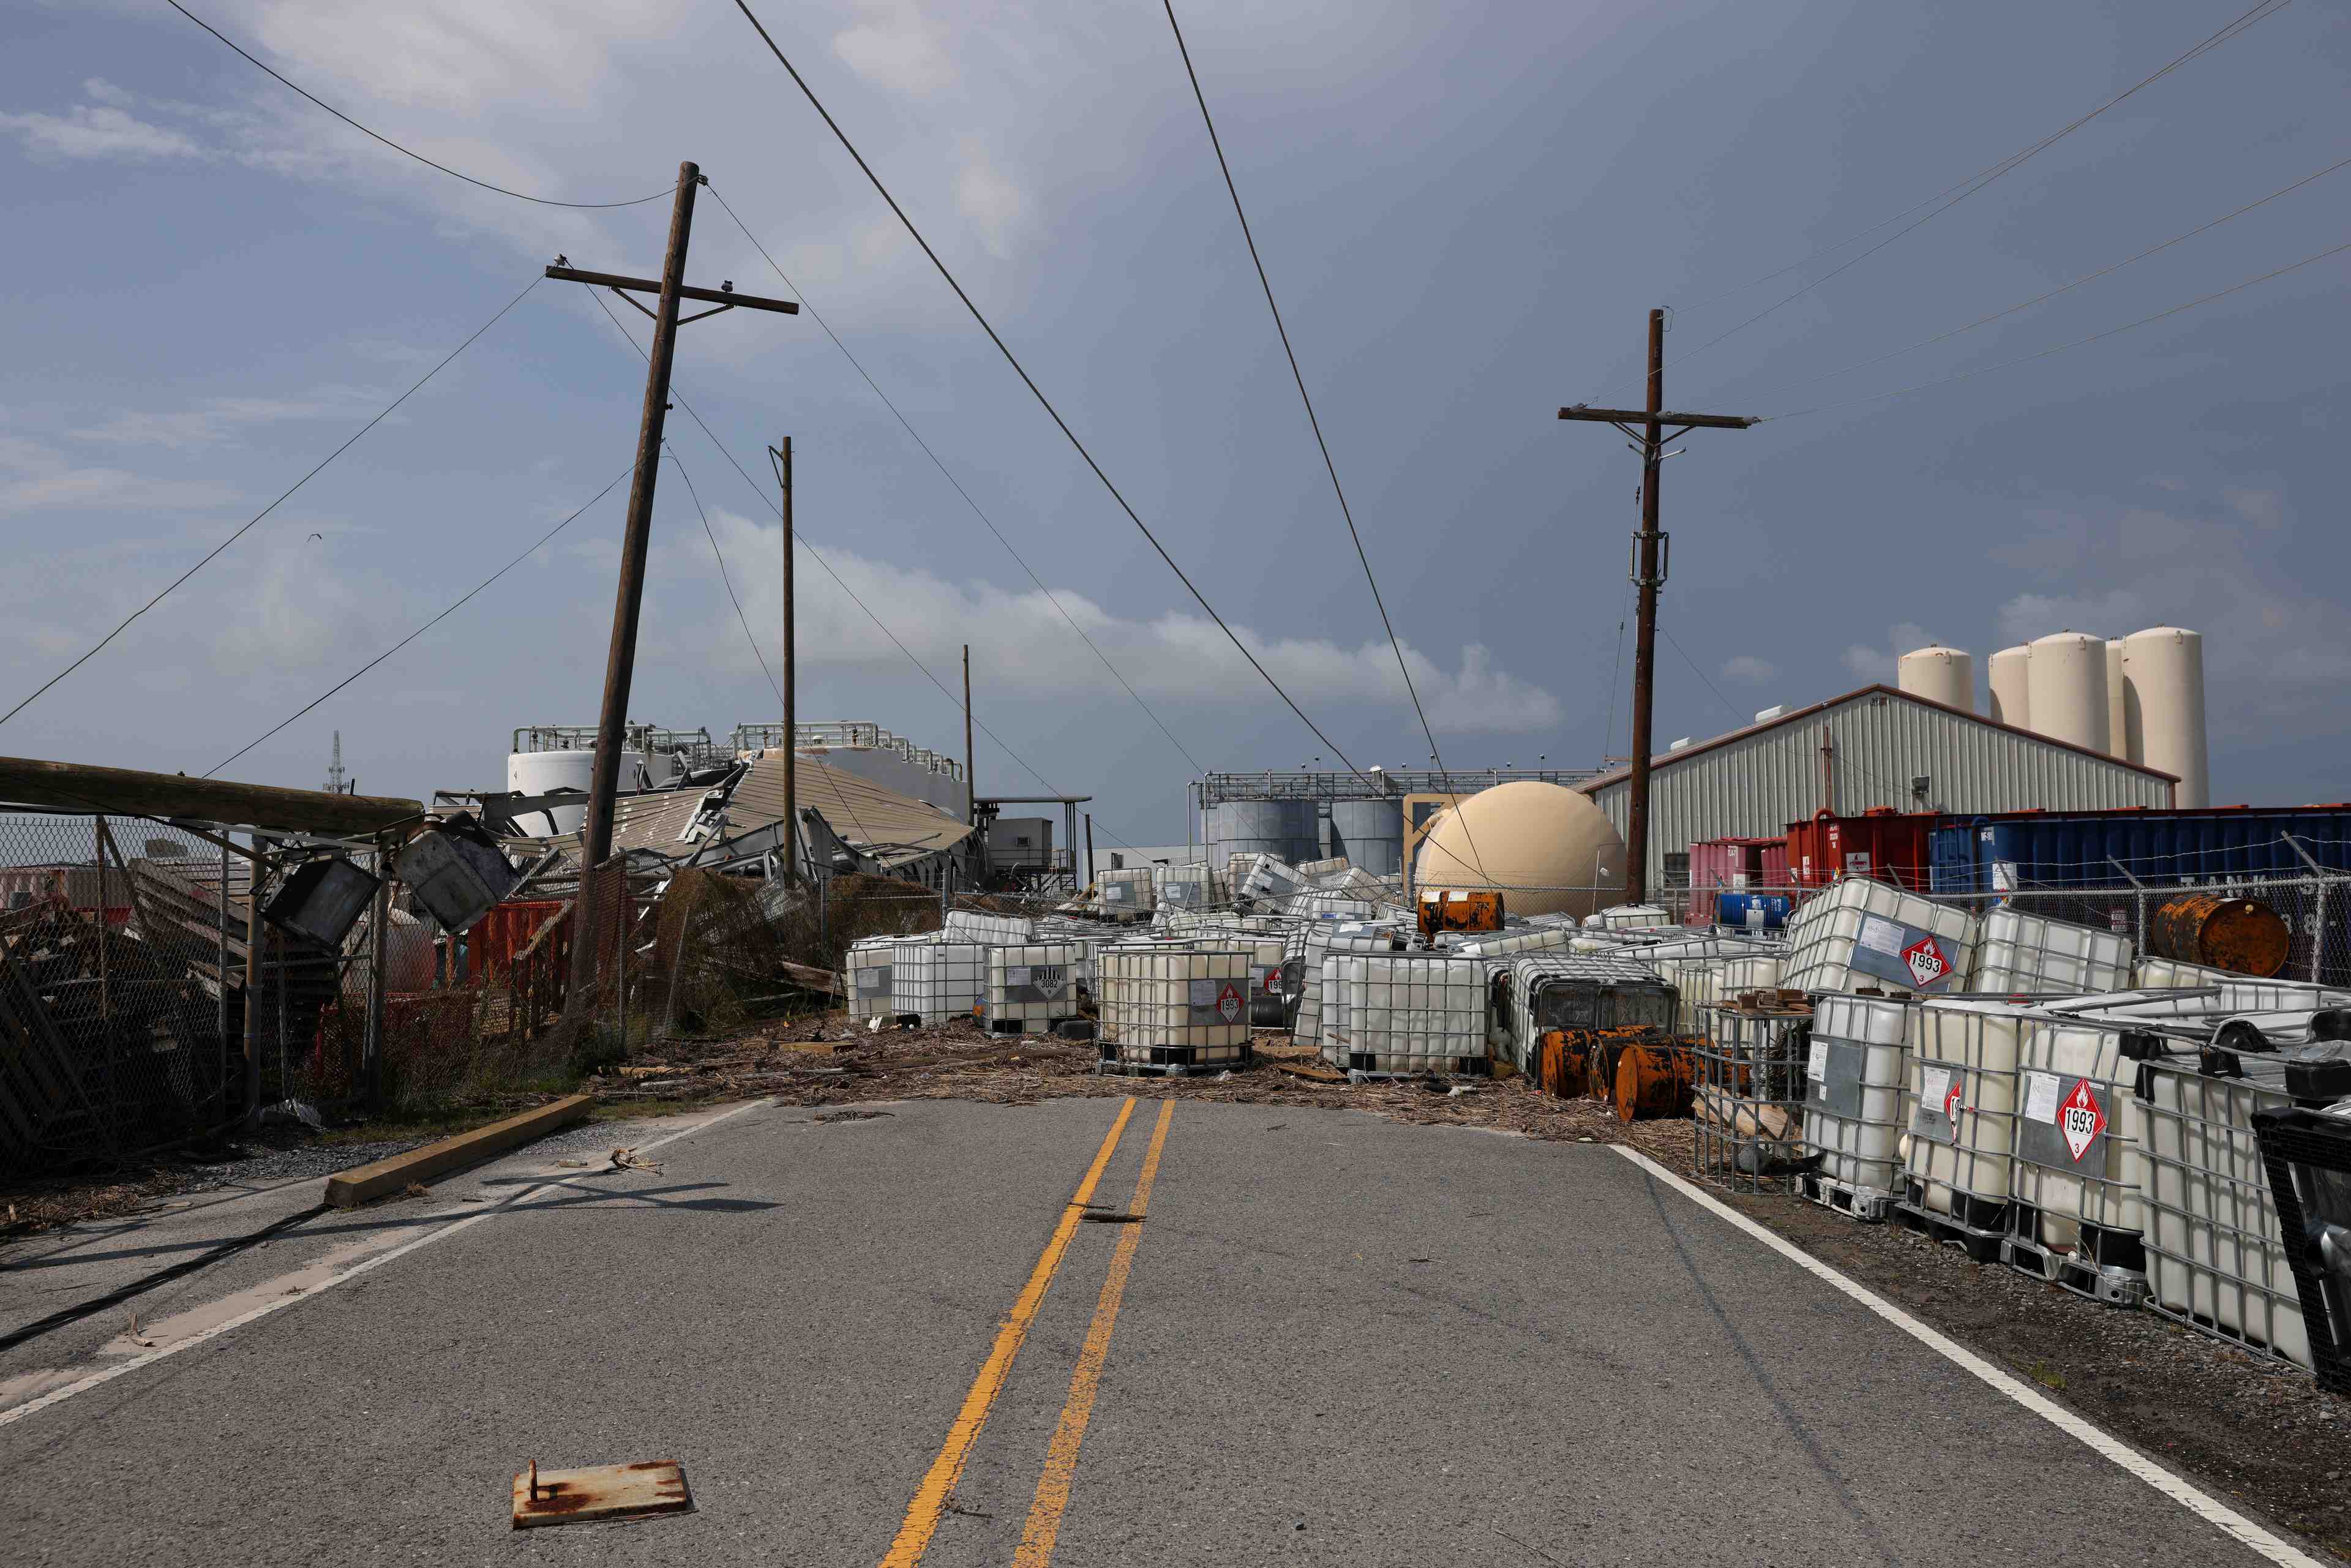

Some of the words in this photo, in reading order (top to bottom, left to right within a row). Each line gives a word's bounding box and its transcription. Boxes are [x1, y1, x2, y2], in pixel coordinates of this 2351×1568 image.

[1912, 953, 1941, 973] 1993
[1041, 980, 1058, 988] 3082
[1269, 981, 1282, 989] 199
[1221, 999, 1239, 1010] 1993
[2067, 1109, 2094, 1134] 1993
[2075, 1143, 2079, 1153] 3
